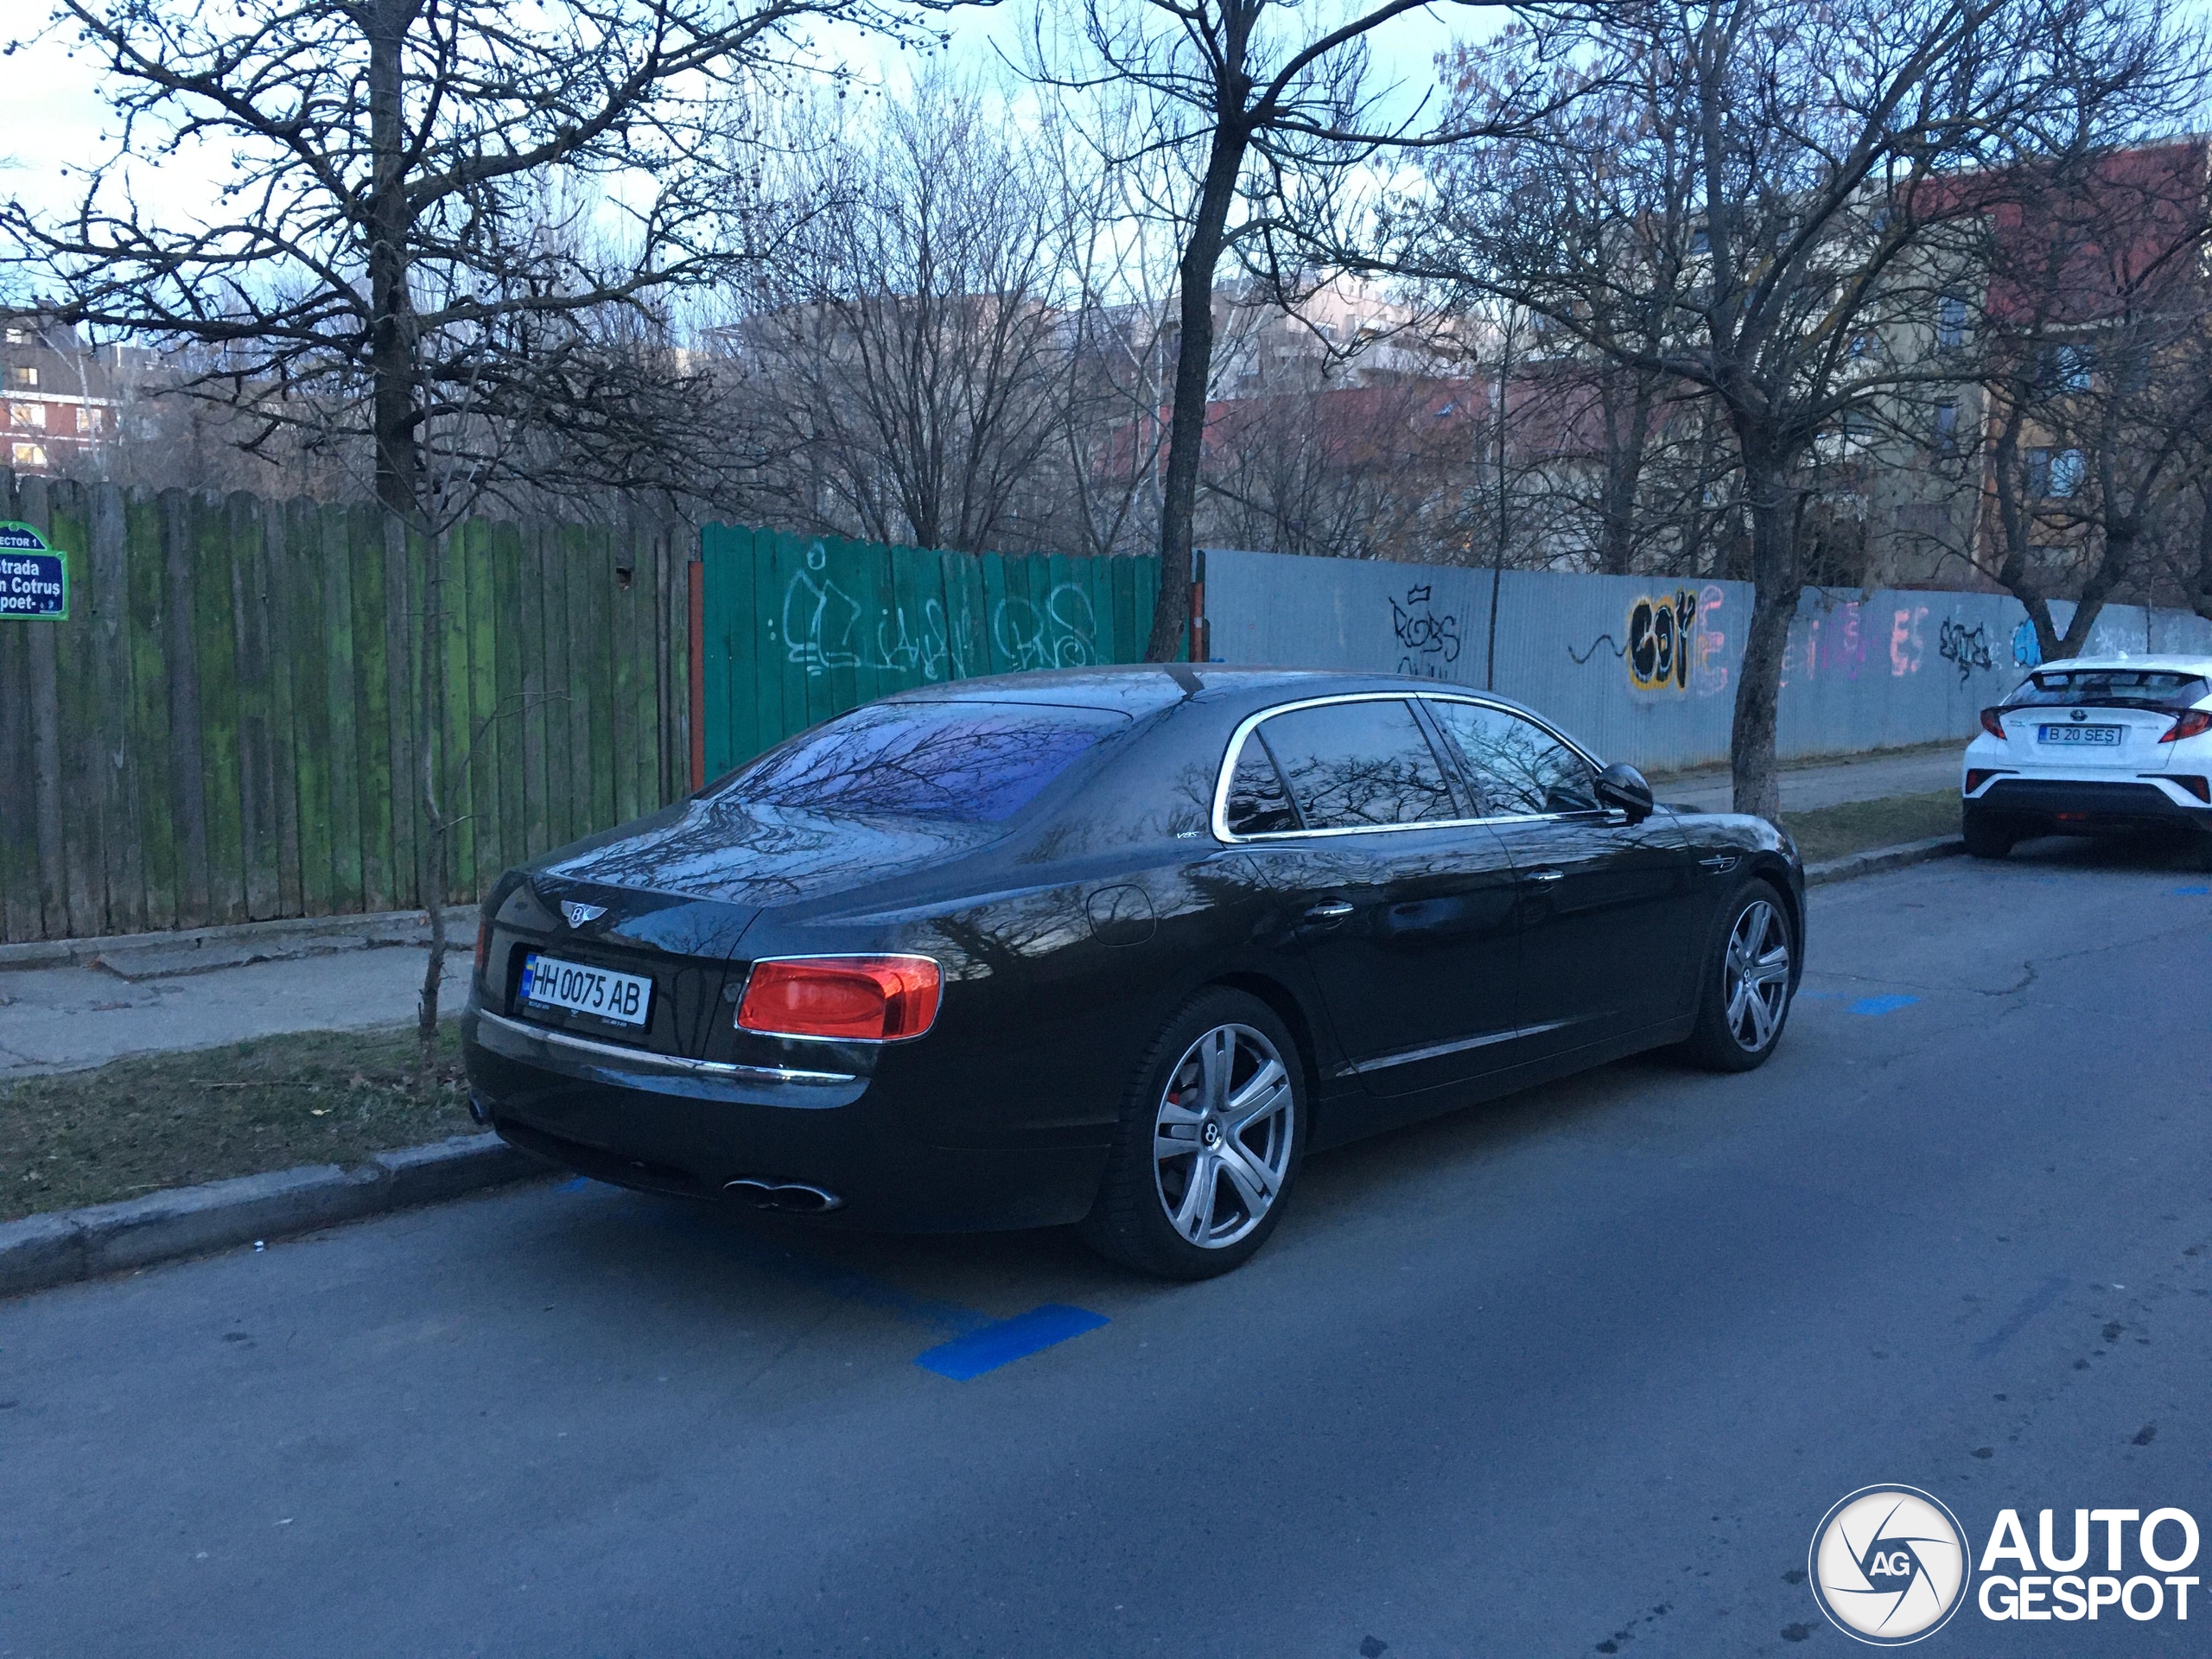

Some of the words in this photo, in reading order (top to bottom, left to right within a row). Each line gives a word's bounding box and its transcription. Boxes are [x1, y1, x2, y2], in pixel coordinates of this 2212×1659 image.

[32, 538, 37, 547] 1
[0, 558, 40, 575] trada
[11, 576, 60, 597] Cotruș
[2050, 728, 2060, 741] B
[2064, 728, 2080, 741] 20
[2084, 729, 2114, 742] SES
[531, 962, 560, 998] HH
[561, 969, 607, 1008] 0075
[607, 980, 641, 1016] AB
